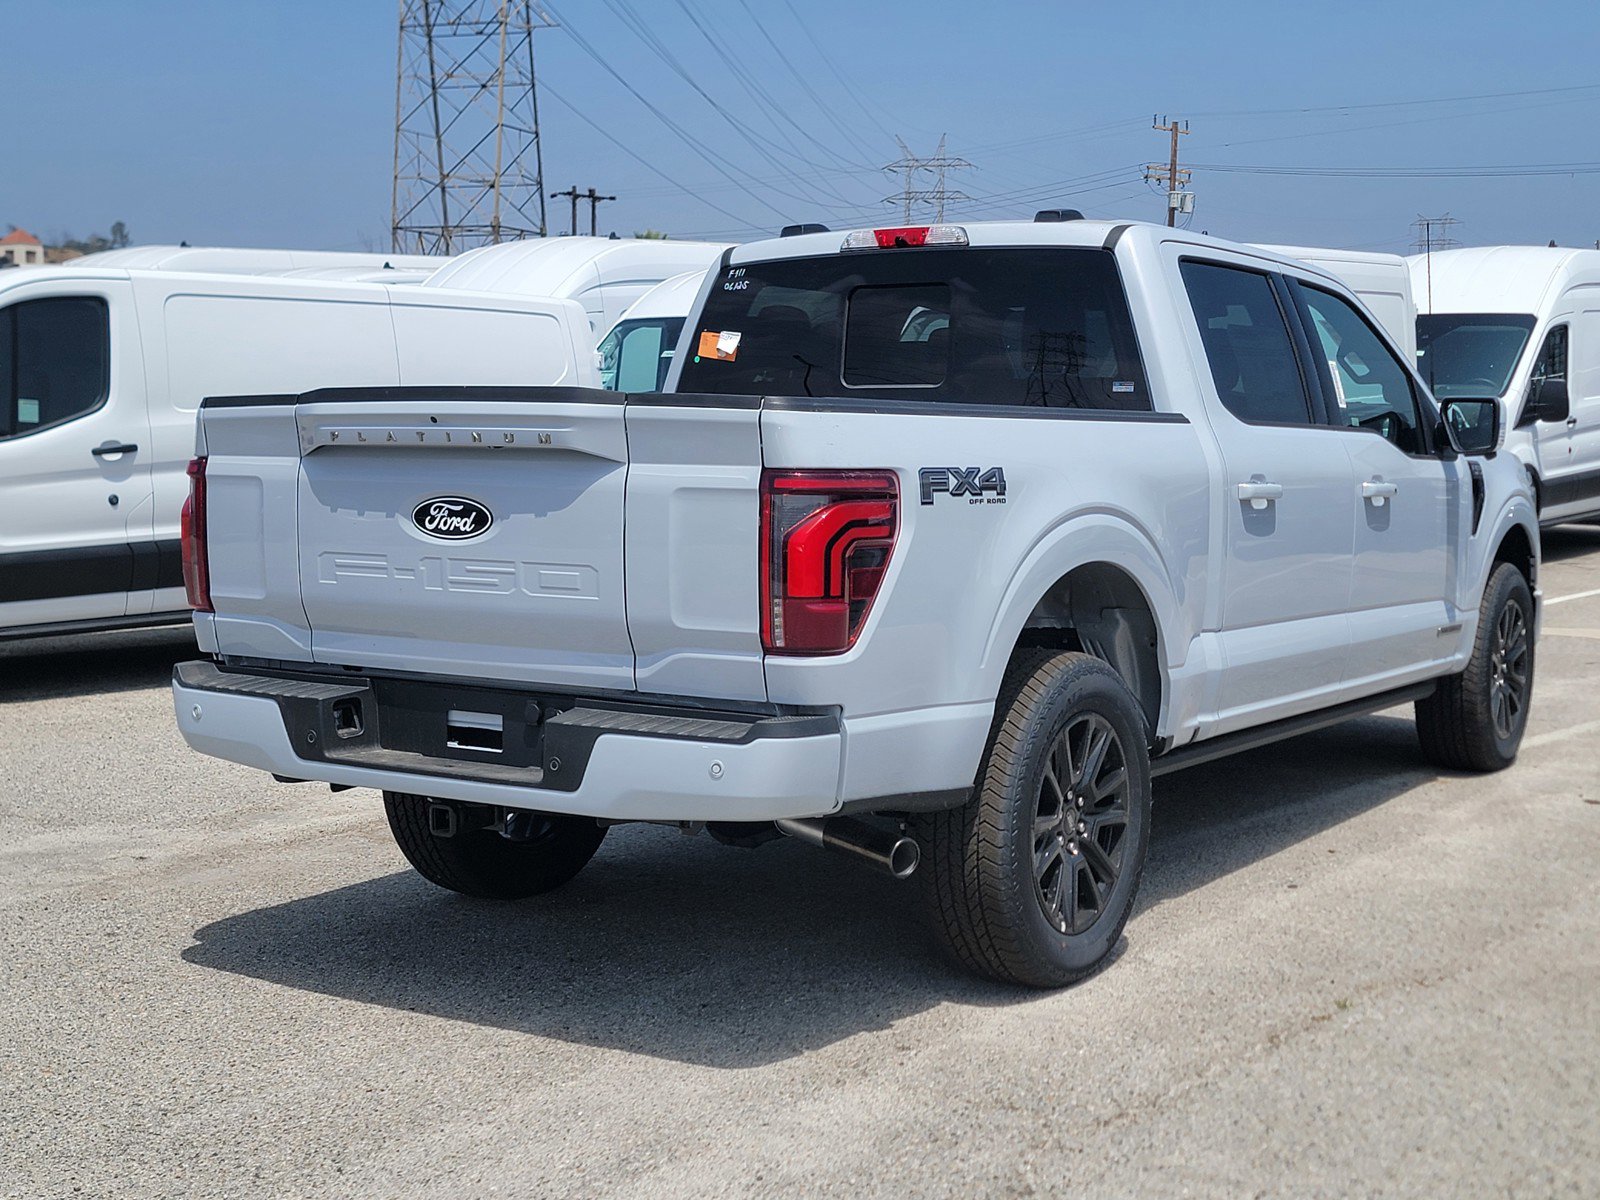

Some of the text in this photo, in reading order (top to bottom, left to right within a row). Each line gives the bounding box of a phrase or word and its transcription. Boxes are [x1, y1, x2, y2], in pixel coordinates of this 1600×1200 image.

[330, 431, 552, 445] PLATINUM
[918, 467, 1006, 505] FX4
[424, 502, 476, 533] Ford
[317, 550, 600, 600] F-150
